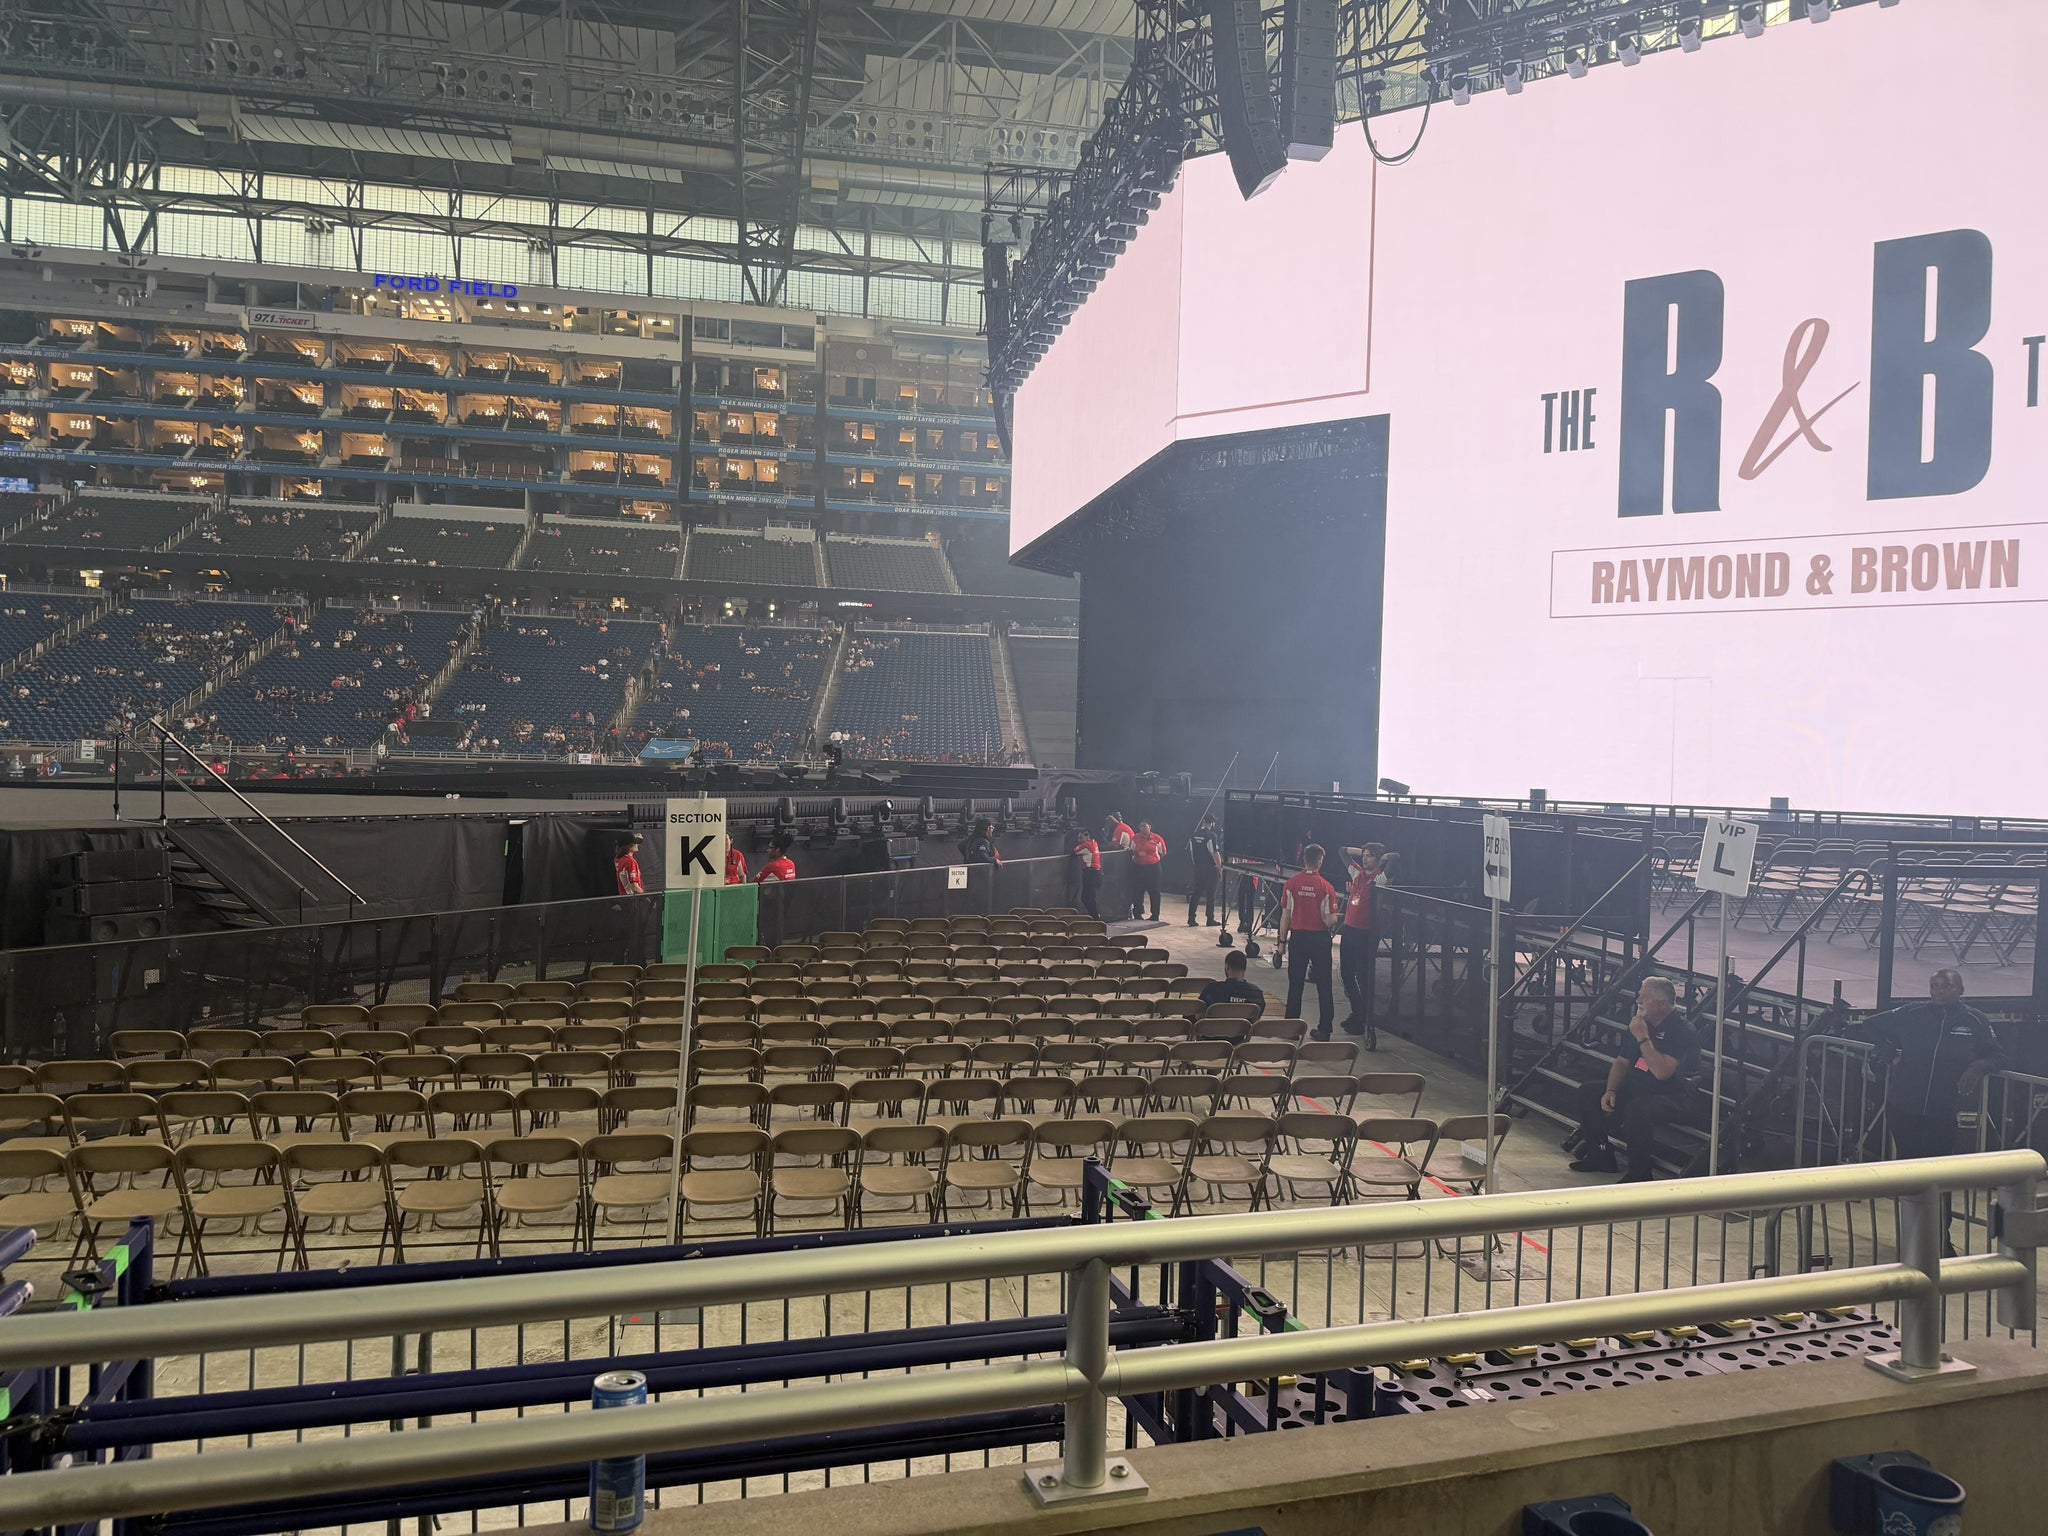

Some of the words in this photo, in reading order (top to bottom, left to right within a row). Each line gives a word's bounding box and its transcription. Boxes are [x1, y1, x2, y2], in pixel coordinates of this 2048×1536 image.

[374, 273, 440, 292] FORD
[448, 280, 518, 298] FIELD
[254, 313, 275, 323] 97.1
[918, 416, 935, 424] LAYNE
[1540, 387, 1597, 454] THE
[0, 451, 36, 459] SPIELMAN
[718, 447, 739, 455] ROGER
[197, 462, 227, 470] PORCHER
[1591, 551, 1790, 604] RAYMOND
[1805, 554, 1834, 596] &
[1850, 538, 2020, 595] BROWN
[670, 813, 722, 824] SECTION
[1718, 822, 1746, 838] VIP
[680, 835, 716, 876] K
[1712, 841, 1736, 877] L
[955, 877, 961, 886] K
